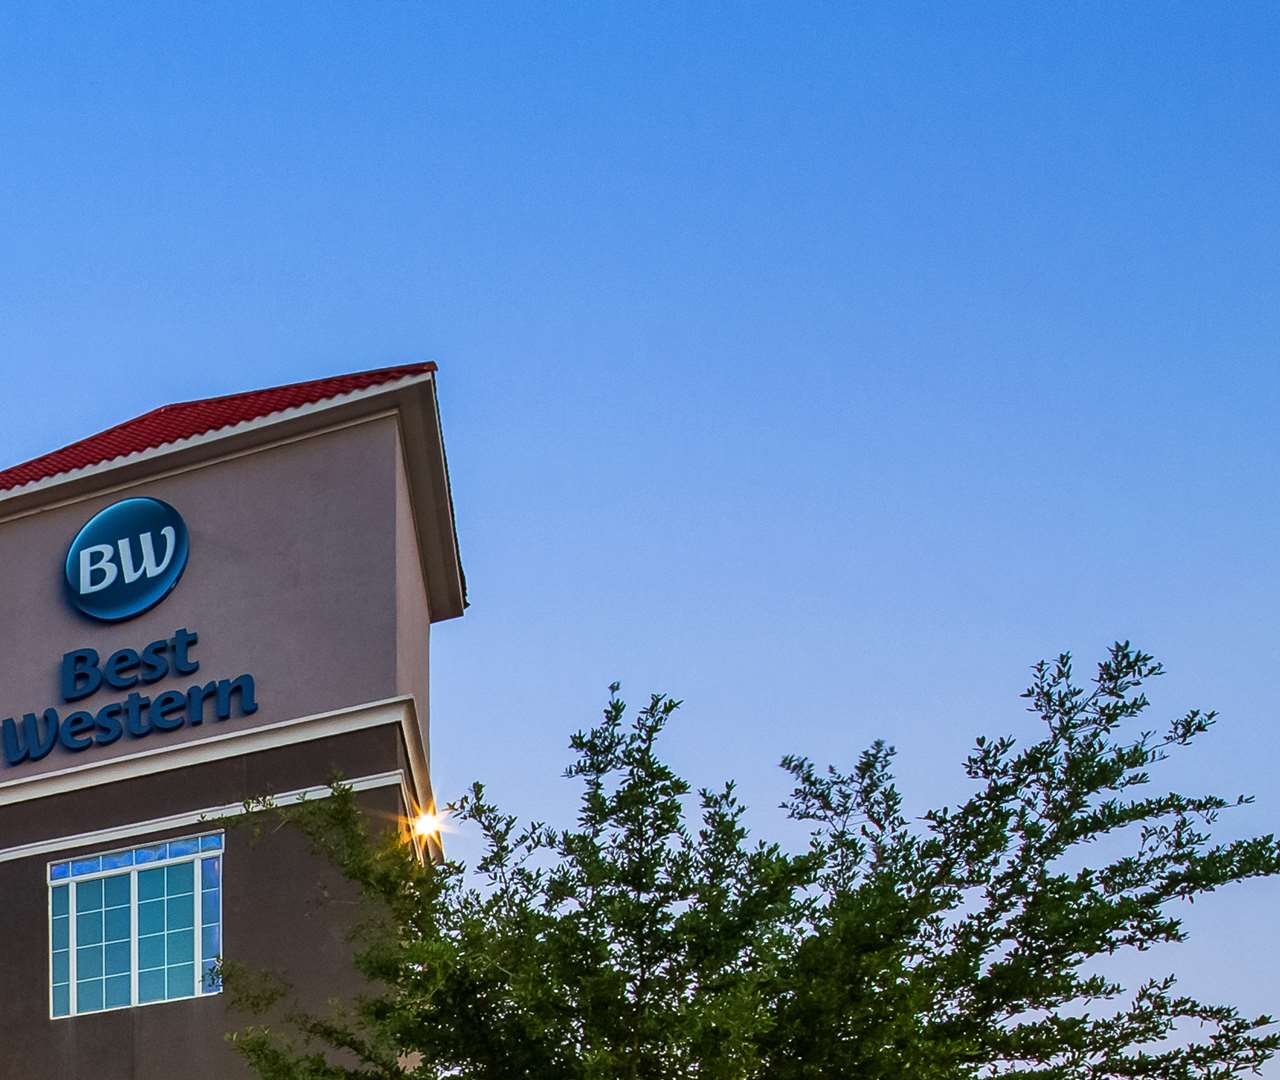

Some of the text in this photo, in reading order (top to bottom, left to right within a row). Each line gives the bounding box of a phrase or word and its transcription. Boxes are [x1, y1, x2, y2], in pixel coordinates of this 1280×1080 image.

[79, 525, 175, 595] BW
[61, 627, 200, 702] Best
[0, 673, 258, 766] Western
